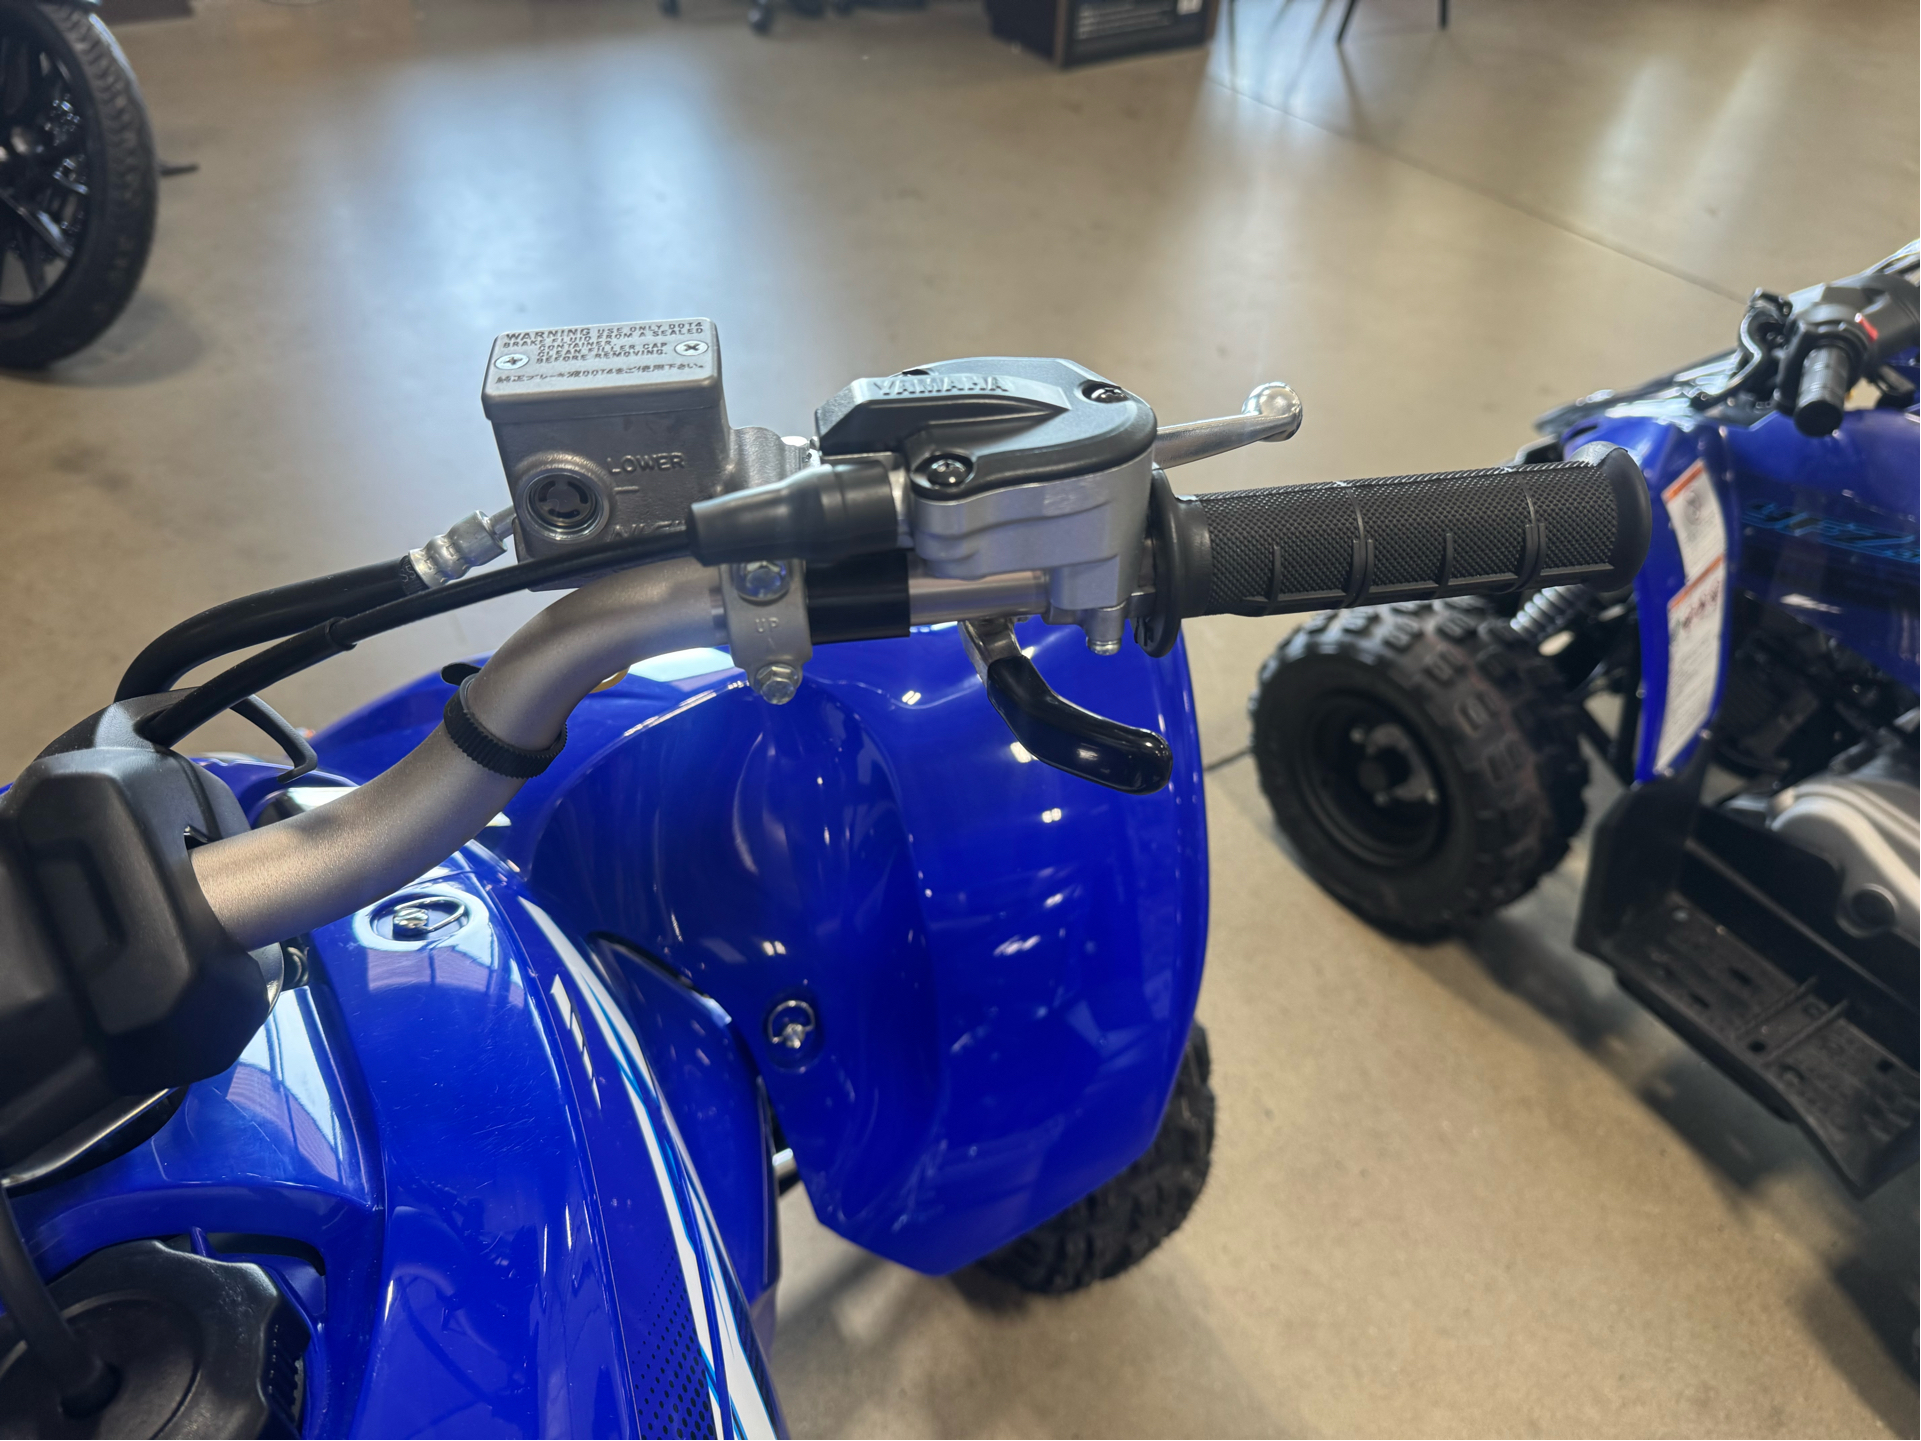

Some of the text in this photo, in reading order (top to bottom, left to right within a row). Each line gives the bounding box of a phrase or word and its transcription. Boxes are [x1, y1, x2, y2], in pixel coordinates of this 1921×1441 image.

[502, 339, 547, 349] BRAKE
[551, 336, 592, 345] FLUID
[596, 332, 633, 340] FROM
[652, 328, 704, 337] SEALED
[505, 322, 703, 341] WARNING USE ONLY DOT4
[536, 354, 588, 364] BEFORE
[537, 342, 668, 358] CLEAN FILLER CAP
[873, 376, 1009, 396] YAMAHA
[606, 452, 686, 474] LOWER
[754, 617, 780, 633] UP
